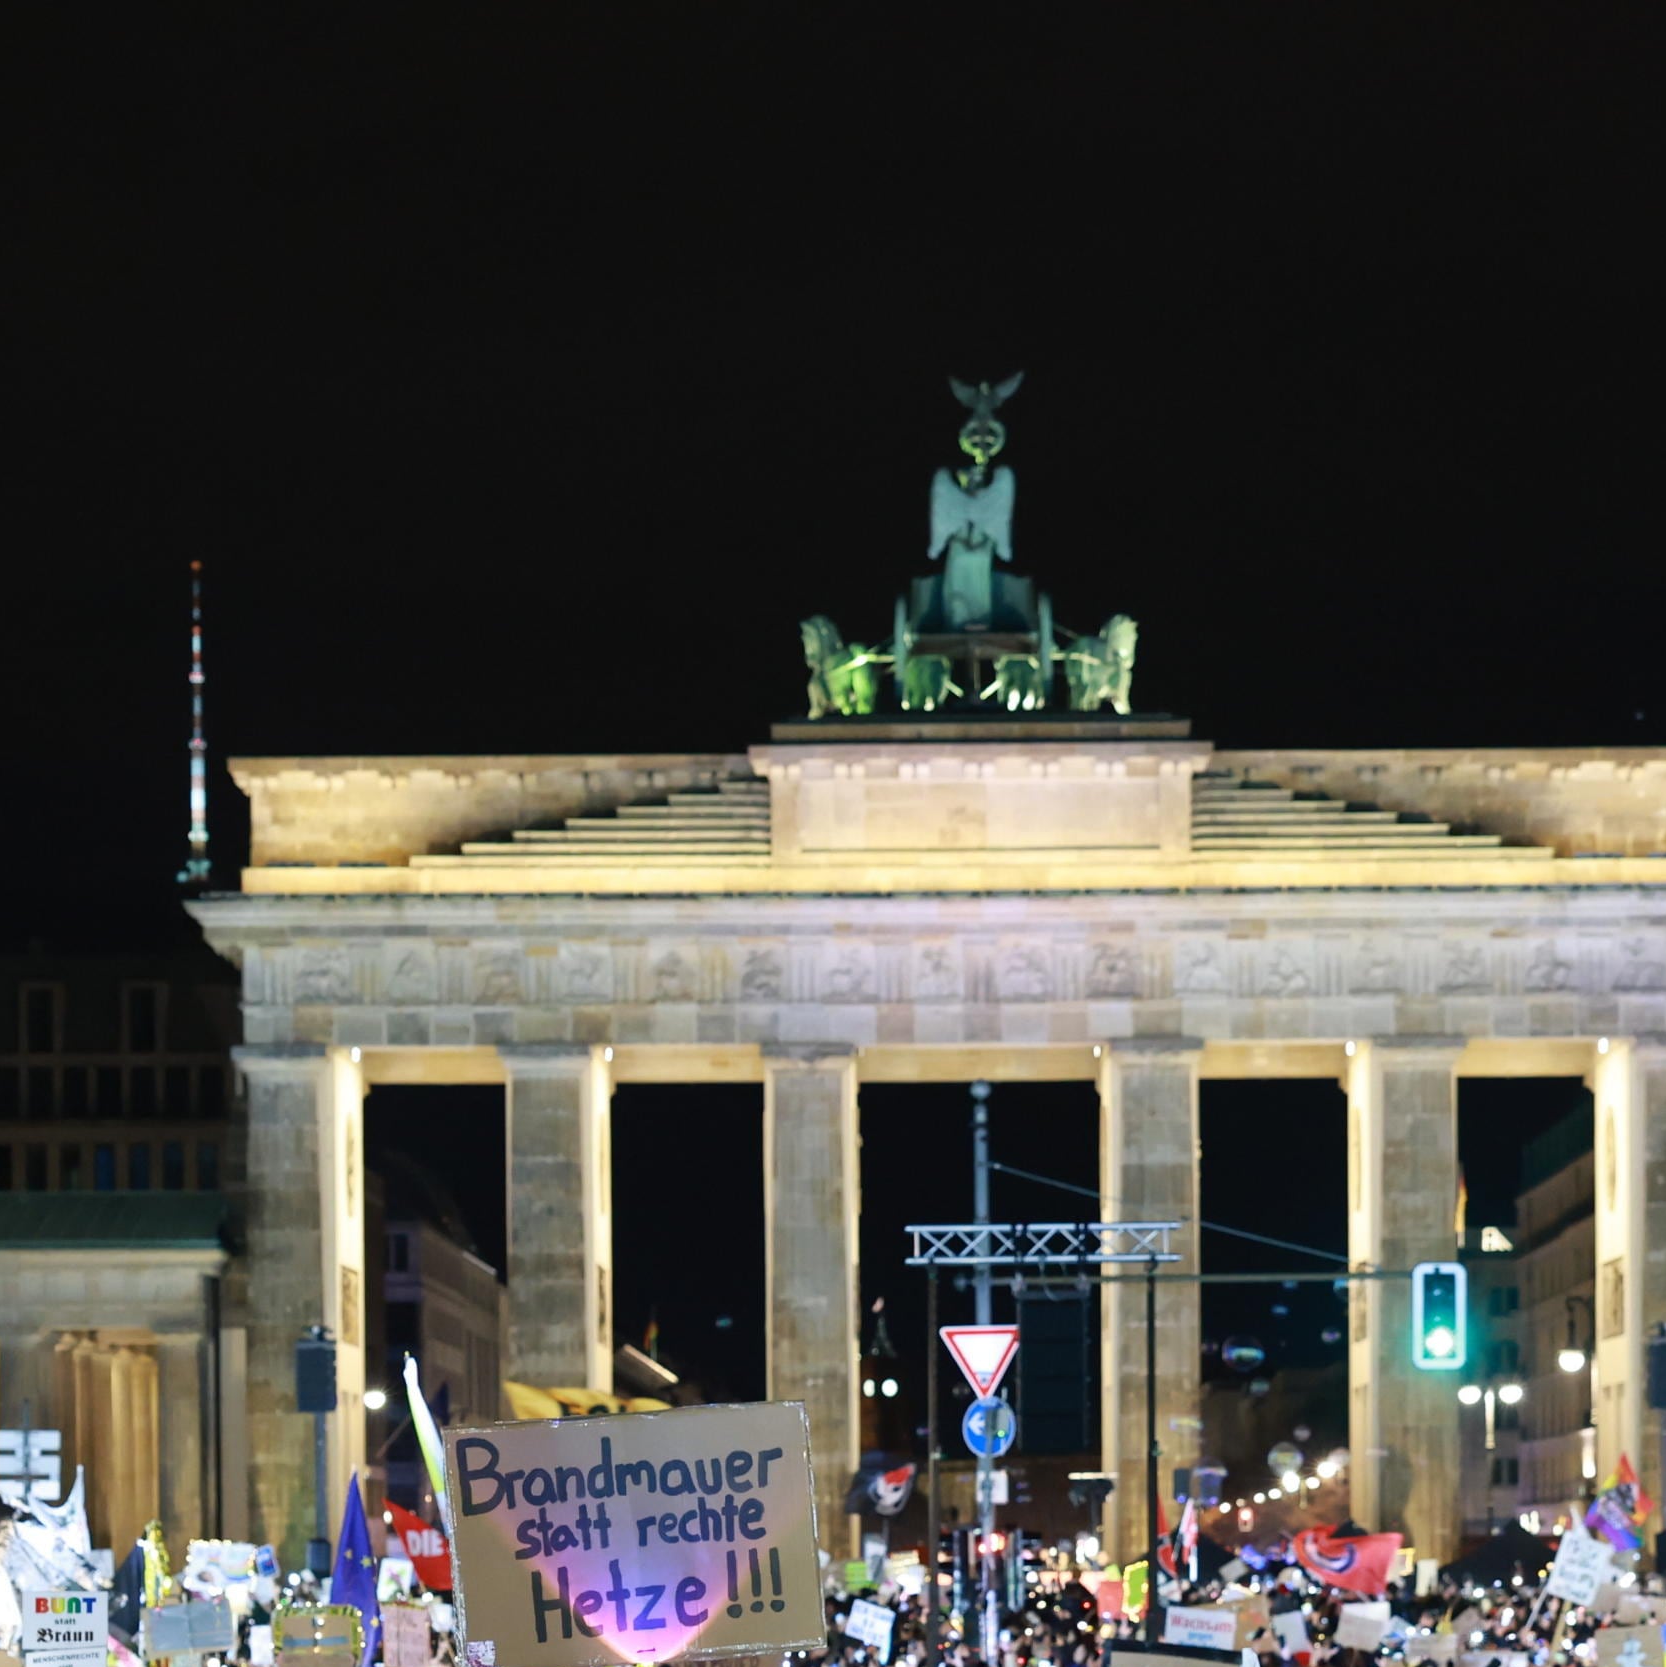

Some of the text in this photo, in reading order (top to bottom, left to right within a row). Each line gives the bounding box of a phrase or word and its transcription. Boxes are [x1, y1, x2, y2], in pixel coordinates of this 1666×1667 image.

[456, 1437, 783, 1516] Brandmauer
[515, 1494, 766, 1560] statt rechte
[406, 1529, 444, 1557] DIE
[35, 1597, 96, 1613] BUNT
[37, 1628, 94, 1643] Braun
[33, 1652, 100, 1664] MENSCHENRECHTE
